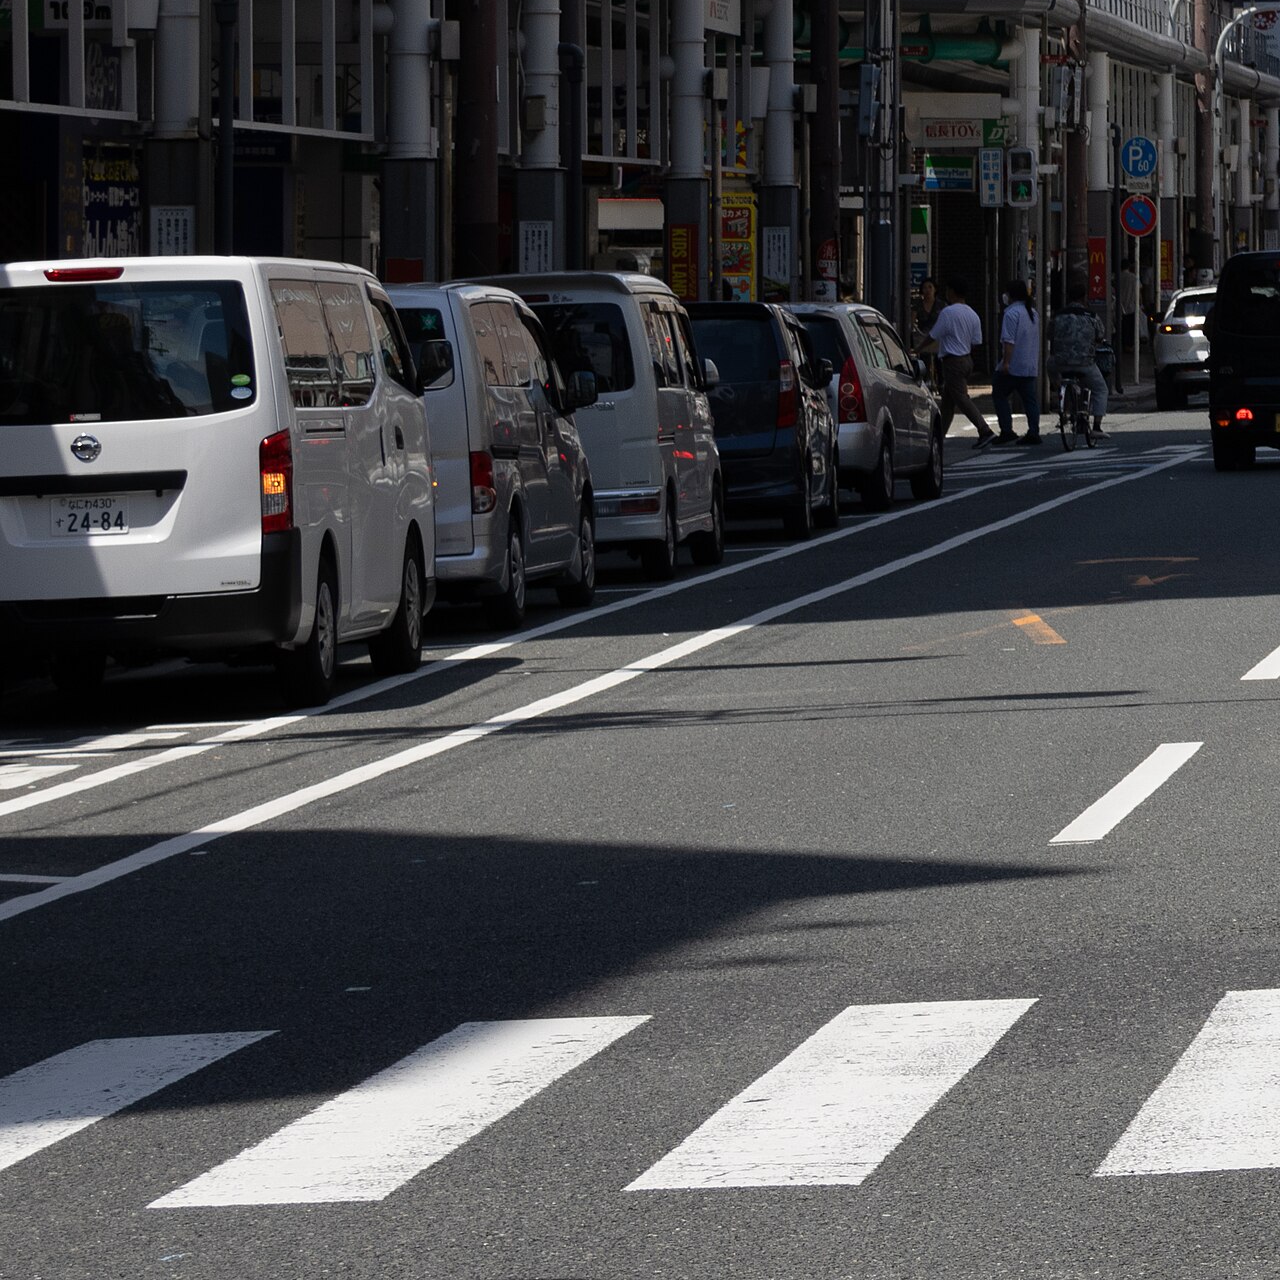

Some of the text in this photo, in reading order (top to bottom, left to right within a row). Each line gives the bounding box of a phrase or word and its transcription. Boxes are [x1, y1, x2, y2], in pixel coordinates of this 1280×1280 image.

[1128, 147, 1142, 171] P
[1138, 160, 1149, 172] 60
[928, 167, 970, 180] FamilyMart
[671, 227, 688, 300] KIDS LAND
[68, 498, 113, 510] なにわ430
[67, 511, 125, 533] 24-84
